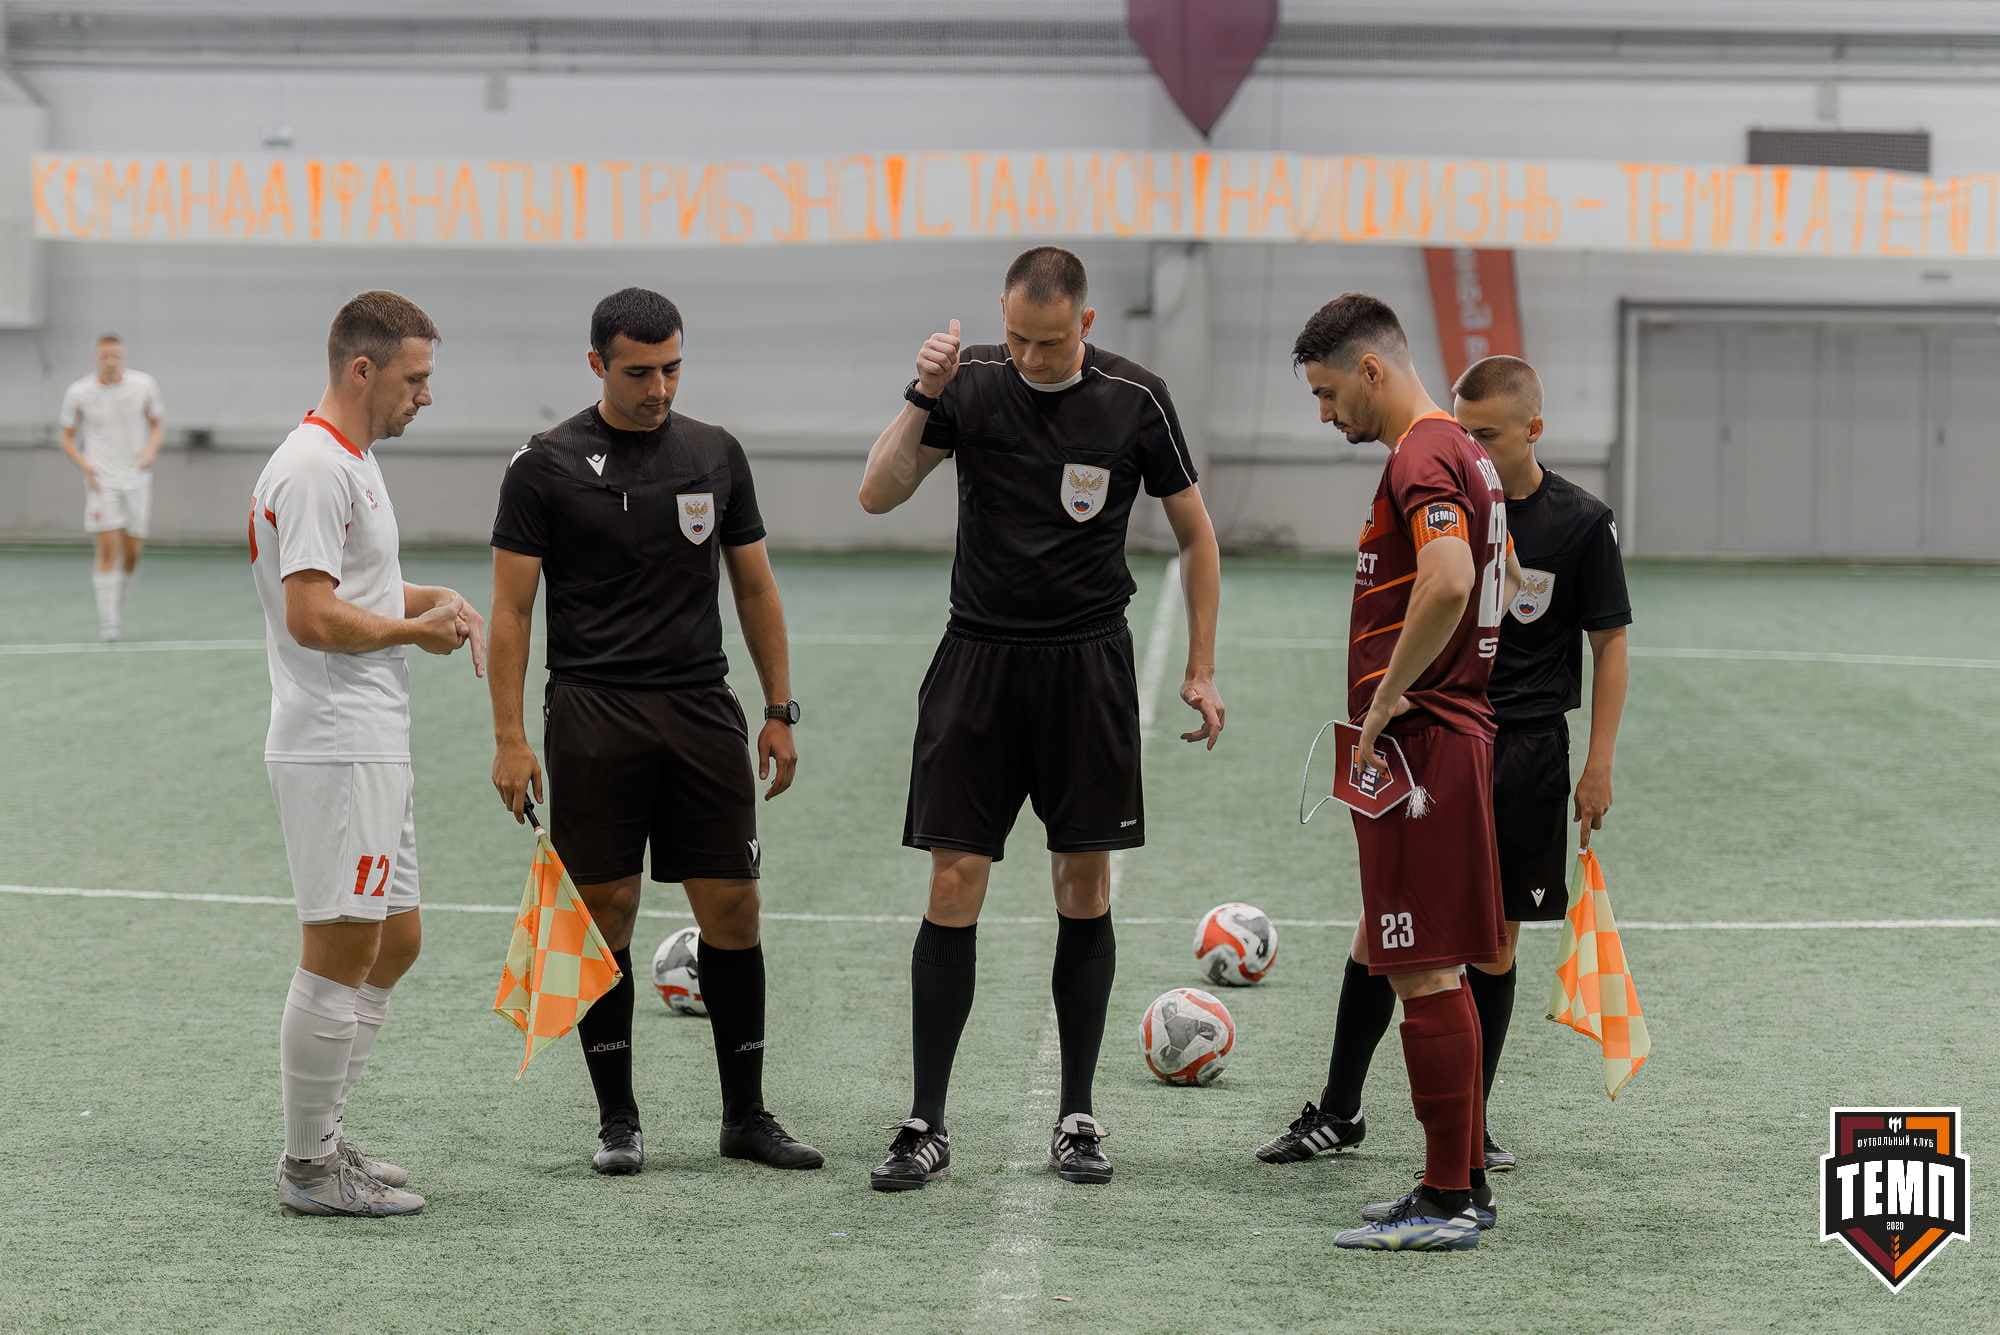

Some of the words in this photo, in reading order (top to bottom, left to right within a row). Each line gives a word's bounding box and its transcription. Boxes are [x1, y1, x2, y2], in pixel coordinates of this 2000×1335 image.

[1428, 510, 1456, 525] ТЕМП
[1381, 912, 1415, 949] 23
[588, 1040, 630, 1052] JÖGEL
